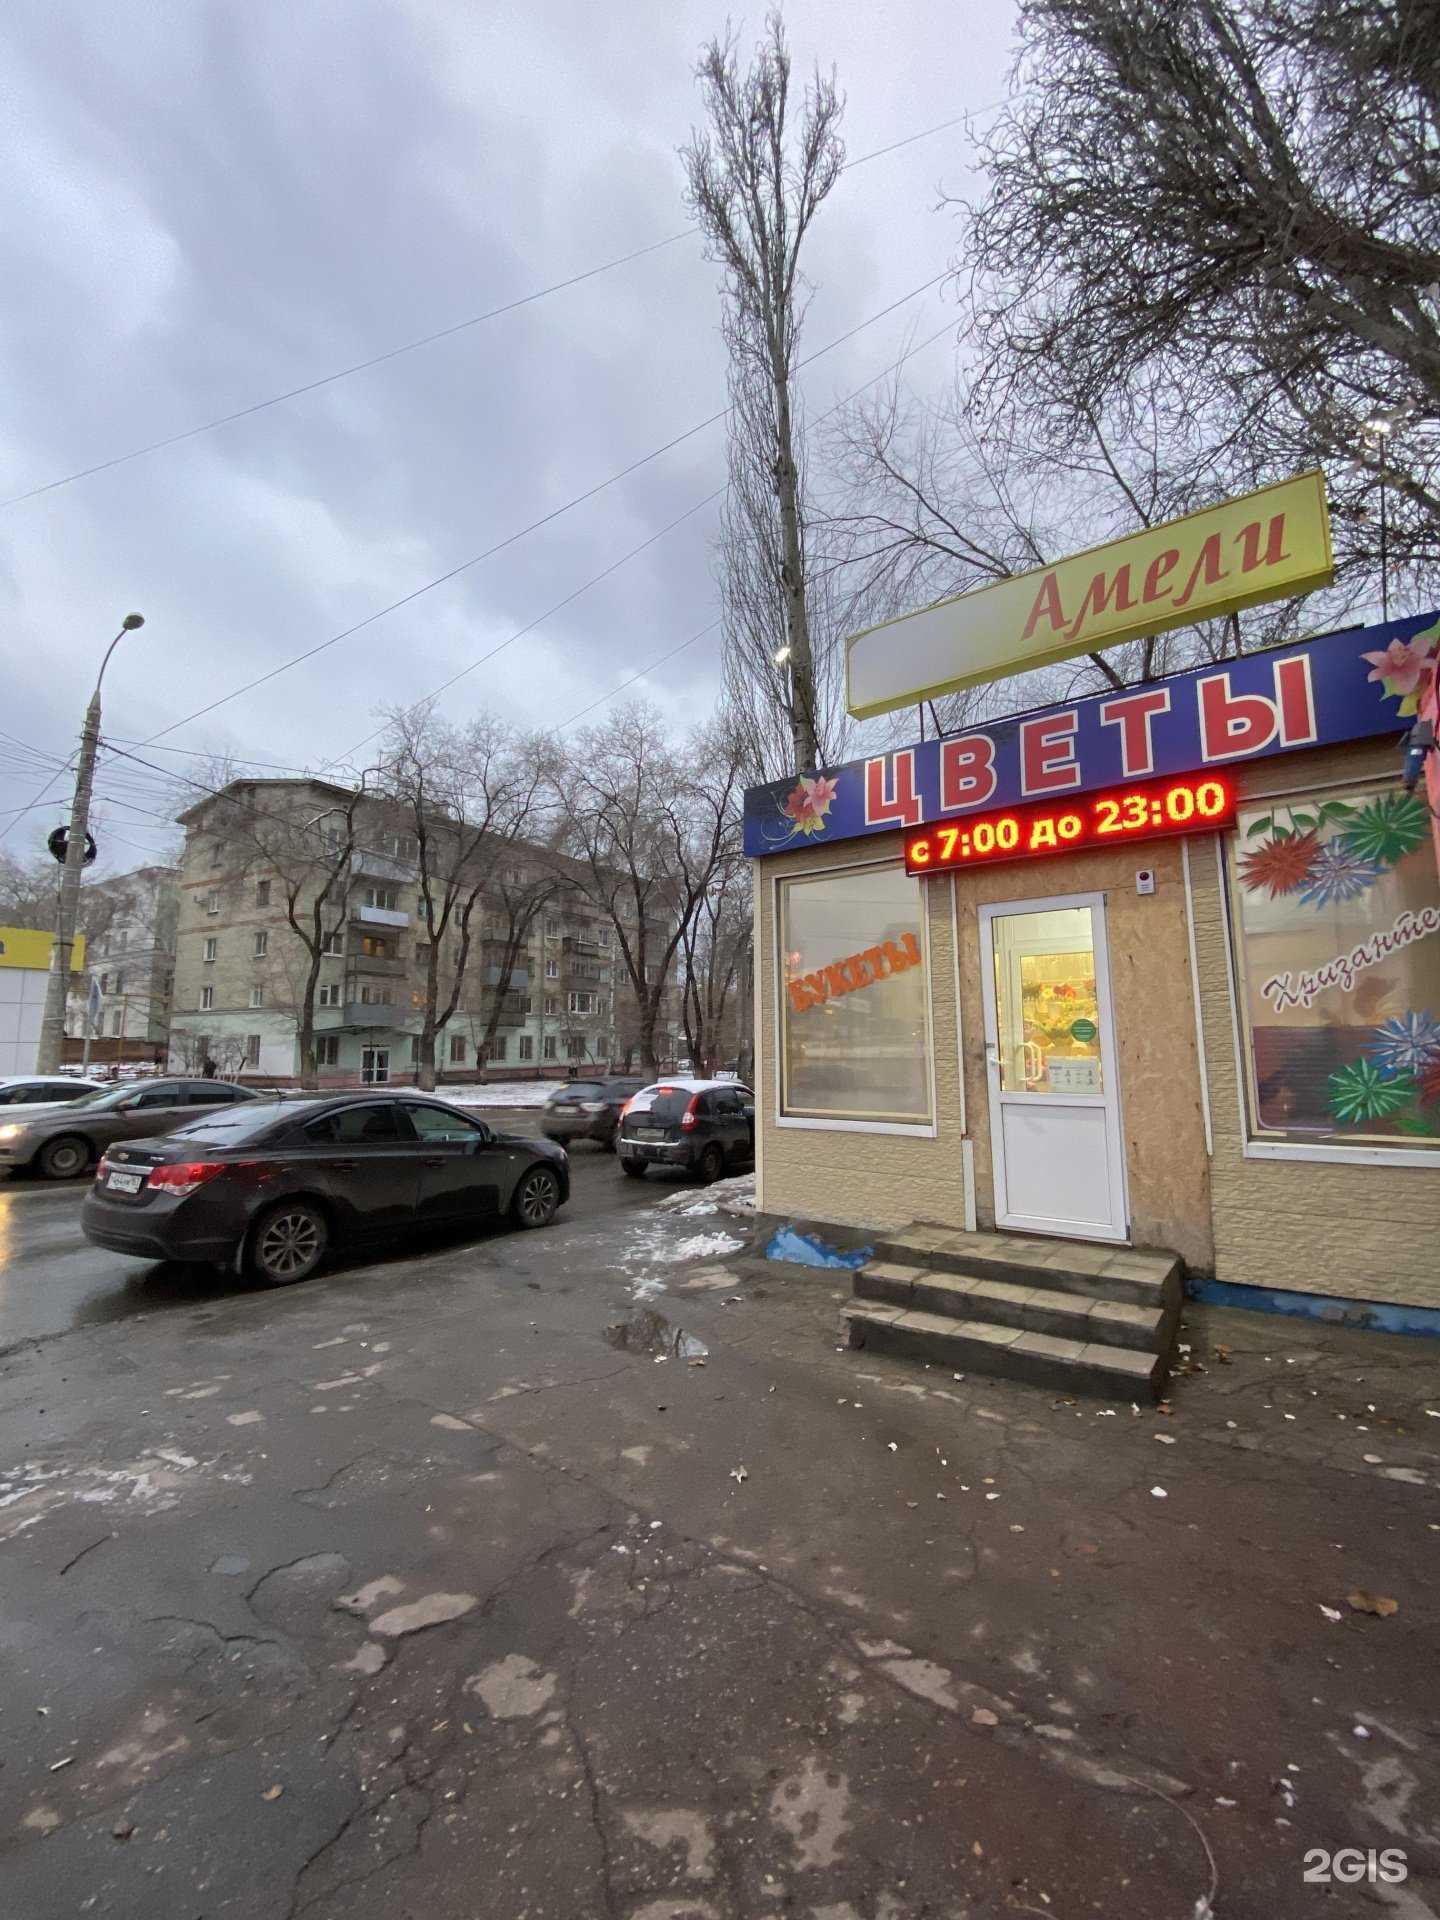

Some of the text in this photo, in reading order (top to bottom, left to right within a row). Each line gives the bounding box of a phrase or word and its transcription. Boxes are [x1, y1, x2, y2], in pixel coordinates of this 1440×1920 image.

[1022, 512, 1290, 641] Амели
[864, 654, 1318, 828] ЦВЕТЫ
[937, 818, 1020, 859] 7:00
[1029, 816, 1082, 849] до
[1095, 781, 1226, 834] 23:00
[788, 931, 922, 1012] БУКЕТЫ
[1261, 907, 1440, 1014] Хризанте
